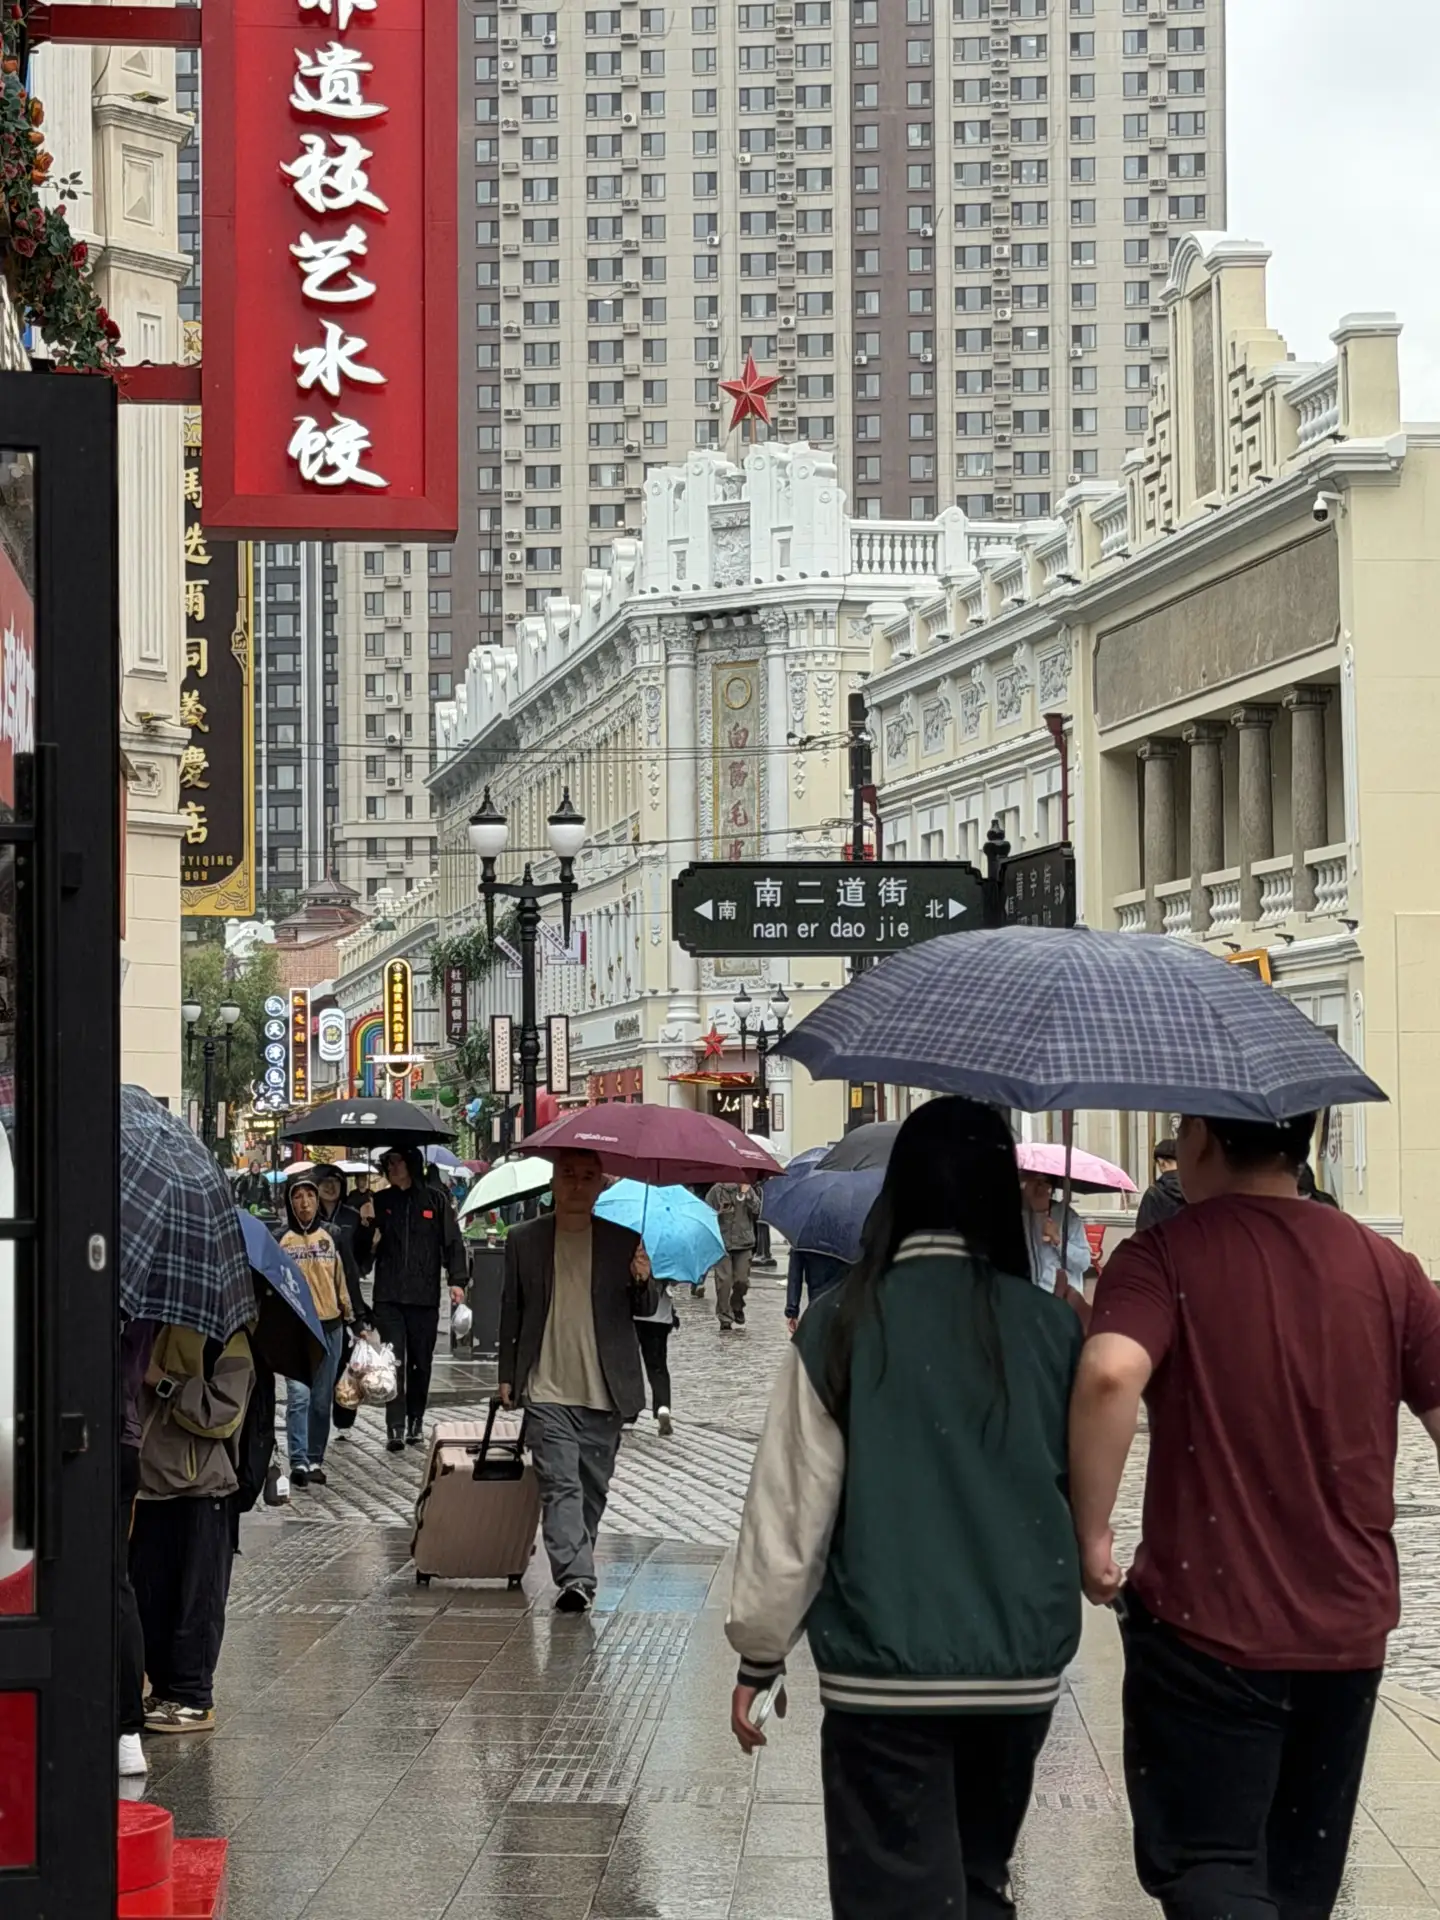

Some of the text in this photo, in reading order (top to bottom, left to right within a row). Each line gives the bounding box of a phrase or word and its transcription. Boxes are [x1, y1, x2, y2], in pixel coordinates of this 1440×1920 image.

[753, 877, 908, 908] 南二道街
[717, 900, 737, 920] 南
[925, 899, 945, 919] 北
[753, 916, 910, 942] nan er dao jie
